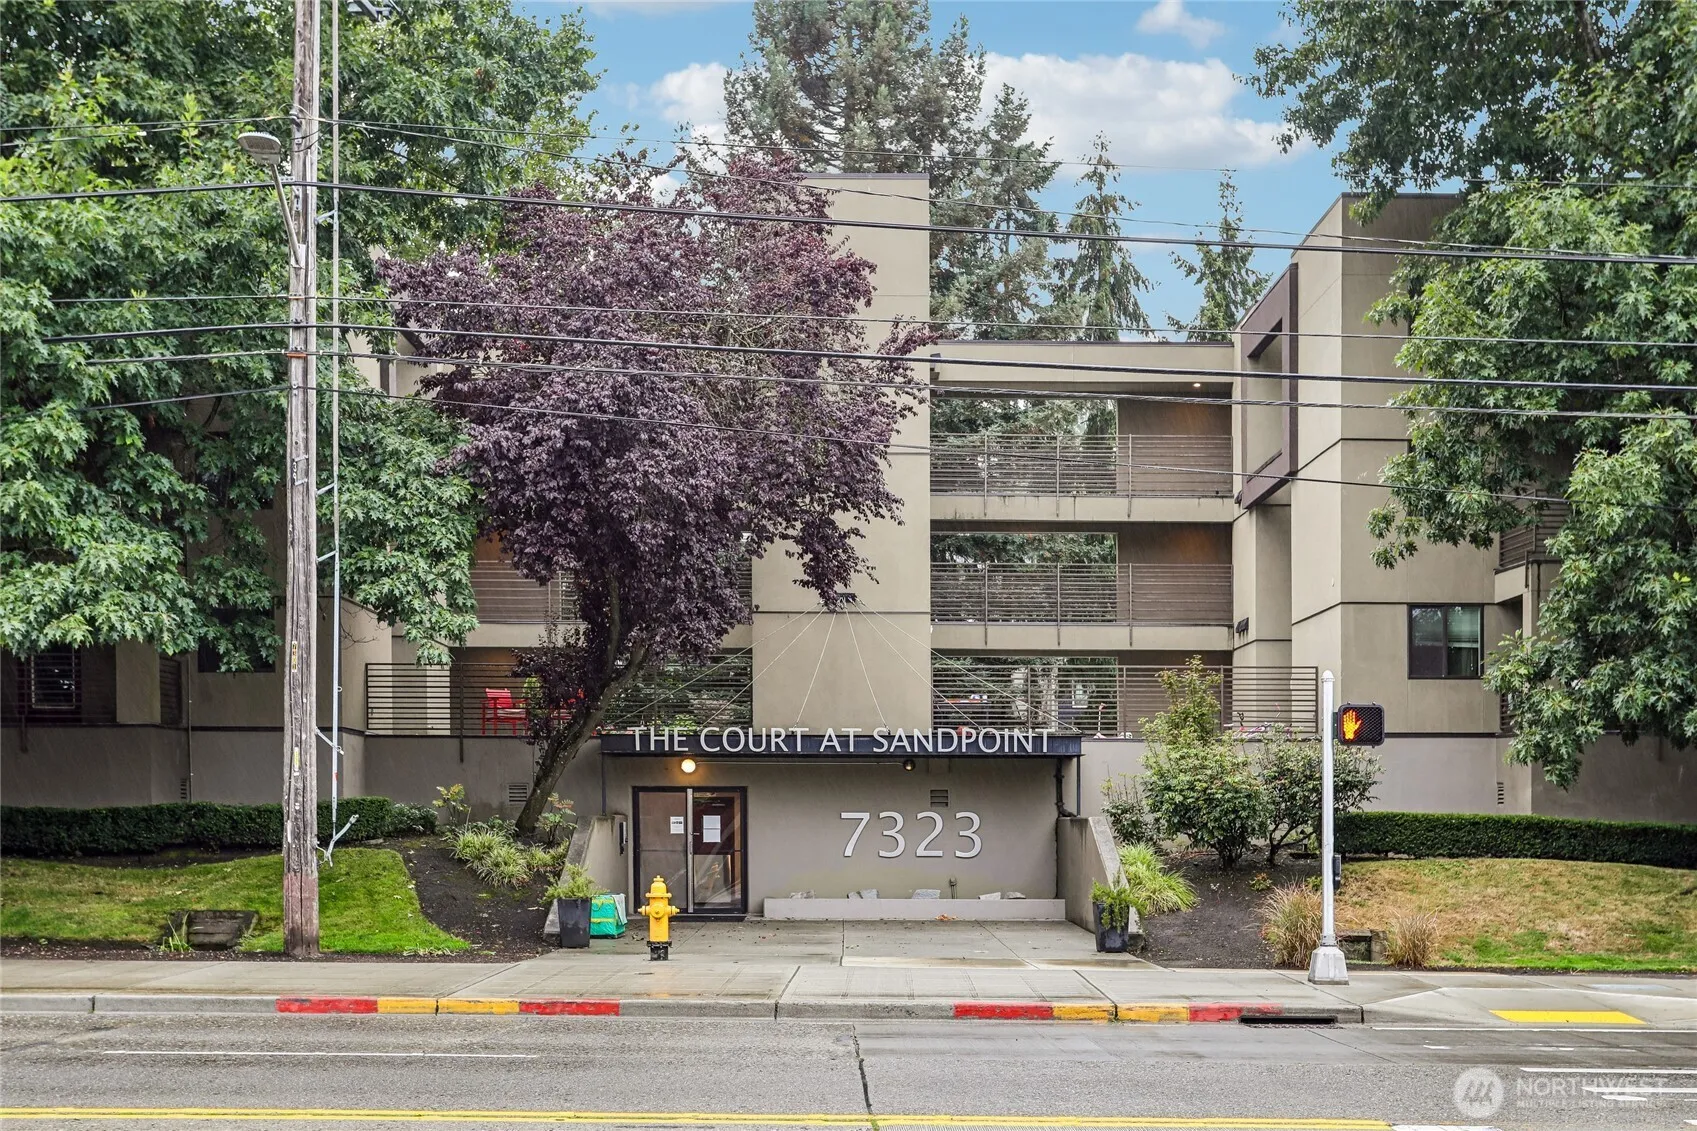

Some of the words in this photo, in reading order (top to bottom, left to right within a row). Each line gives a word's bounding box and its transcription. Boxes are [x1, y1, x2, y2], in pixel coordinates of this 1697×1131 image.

[626, 727, 689, 751] THE
[700, 727, 809, 752] COURT
[819, 727, 862, 752] AT
[872, 727, 1056, 753] SANDPOINT
[840, 811, 983, 858] 7323
